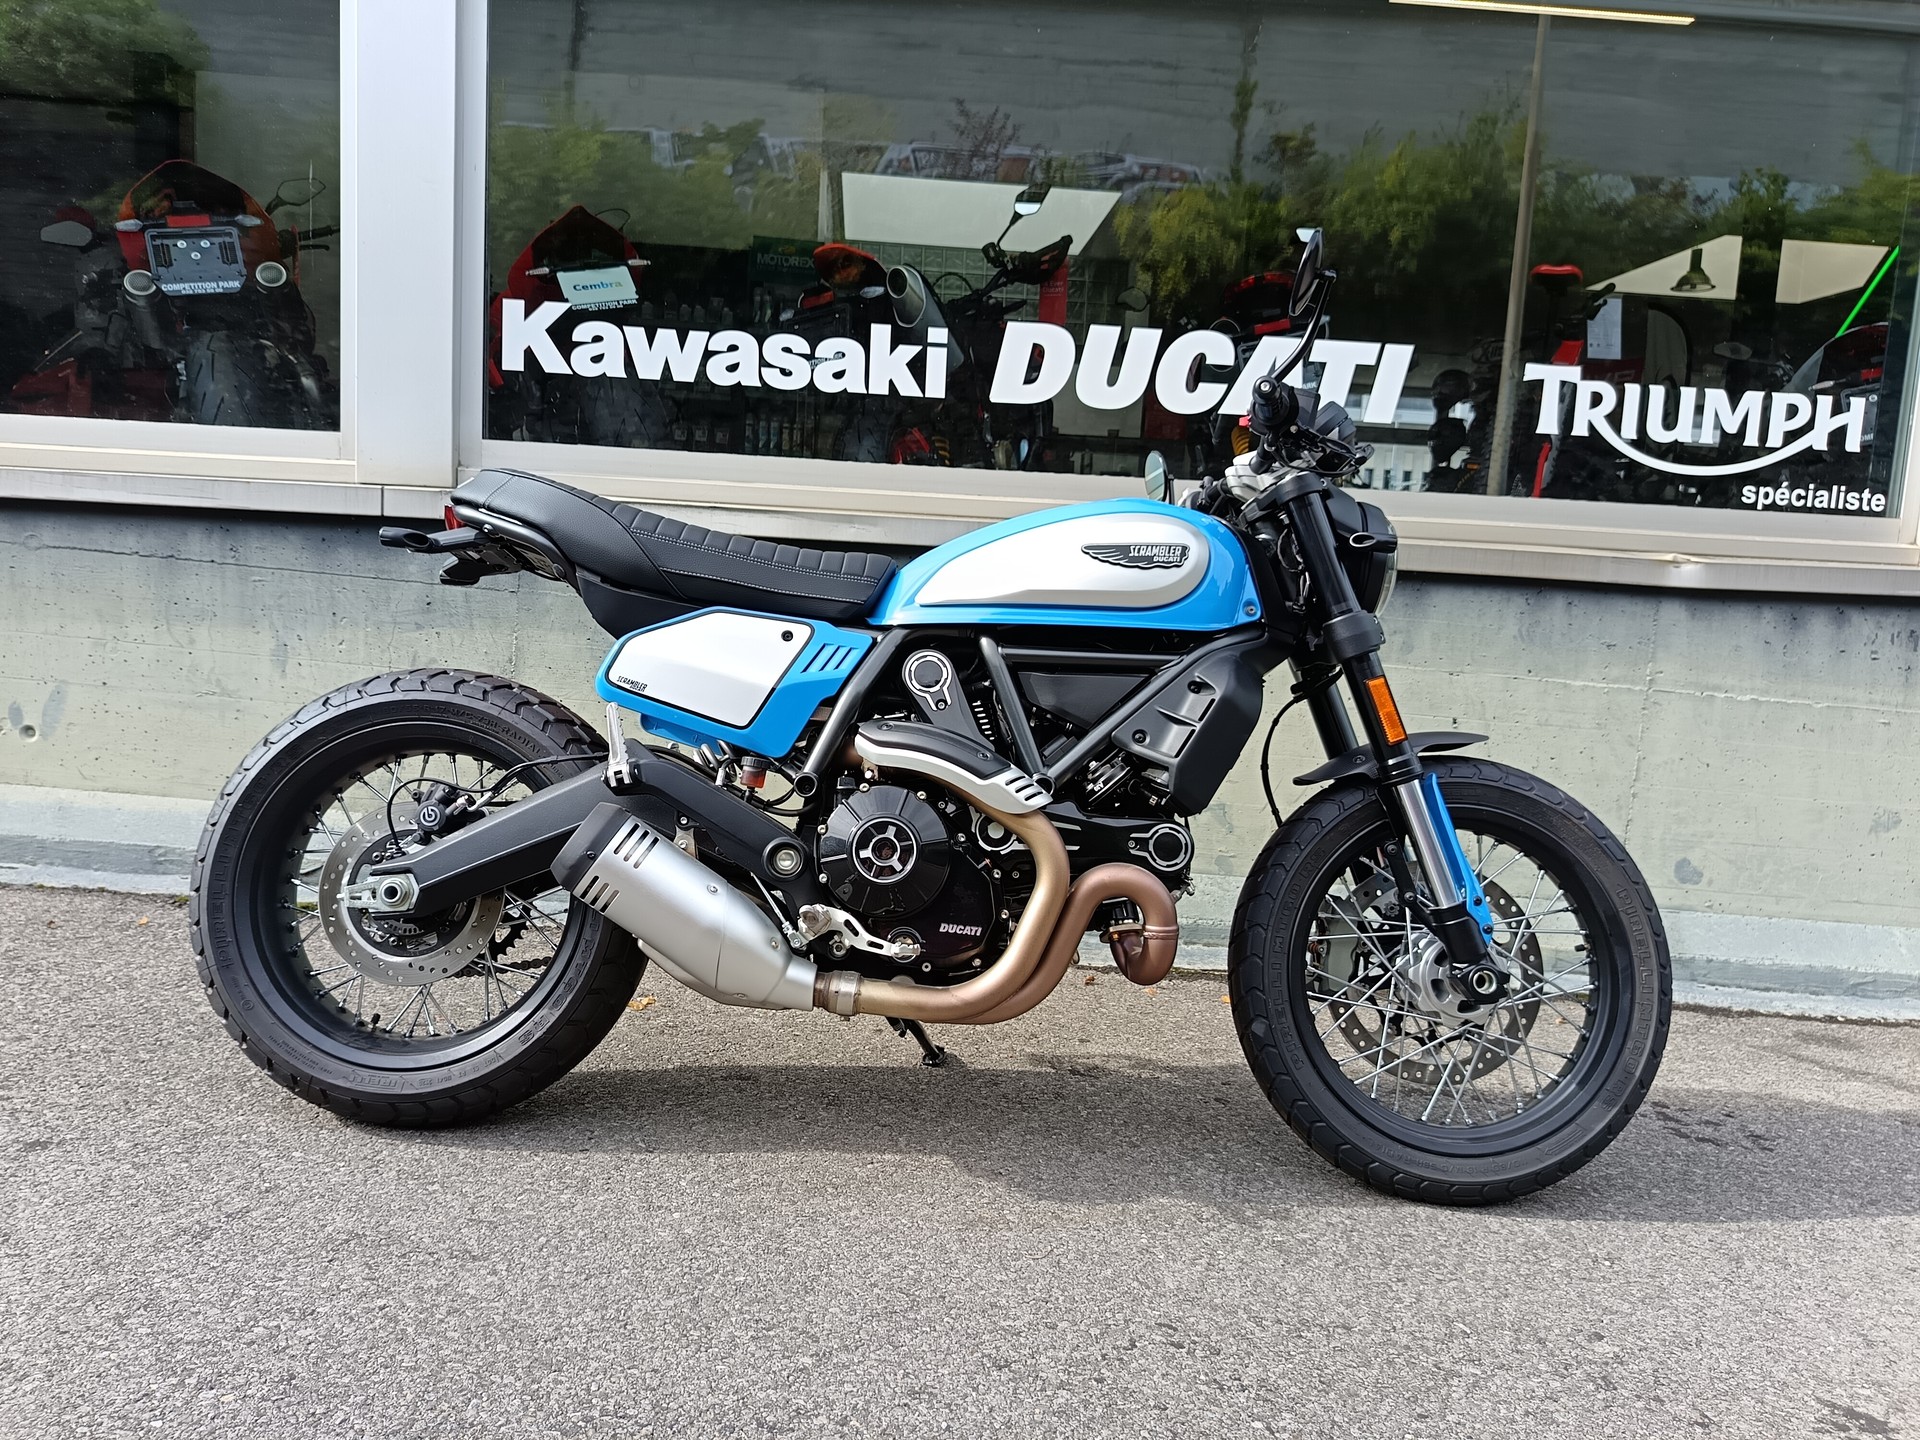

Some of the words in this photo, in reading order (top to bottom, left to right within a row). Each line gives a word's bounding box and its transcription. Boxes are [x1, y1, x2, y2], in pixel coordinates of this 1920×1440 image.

[757, 253, 815, 268] MOTOREX
[161, 281, 218, 291] COMPETITION
[219, 280, 241, 288] PARK
[573, 281, 624, 292] Cembra
[501, 297, 949, 399] Kawasaki
[989, 320, 1415, 424] DUCATI
[1522, 362, 1866, 476] TRIUMPH
[1740, 481, 1886, 513] spécialiste
[1128, 546, 1181, 557] SCRAMBLER
[617, 675, 648, 689] SCRAMBLER
[939, 923, 982, 936] DUCATI
[1615, 887, 1654, 995] PIRELLI
[1270, 962, 1305, 1070] PIRELLI
